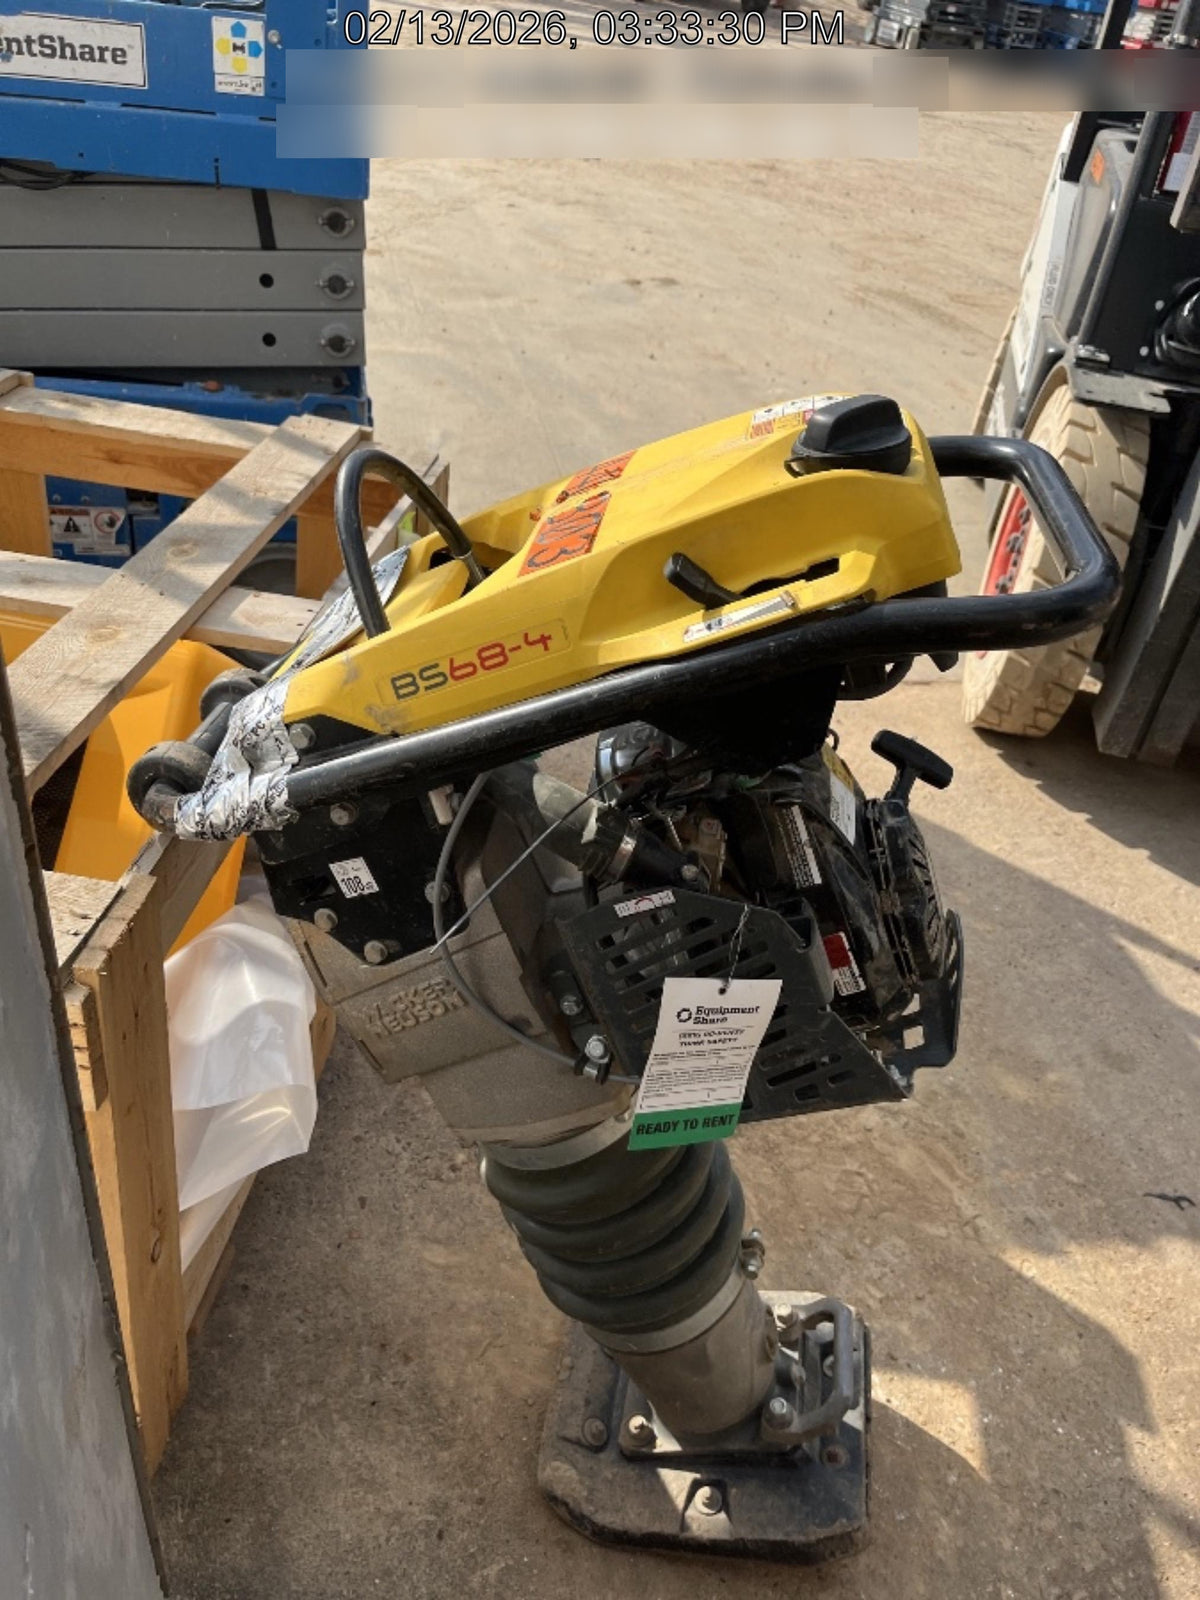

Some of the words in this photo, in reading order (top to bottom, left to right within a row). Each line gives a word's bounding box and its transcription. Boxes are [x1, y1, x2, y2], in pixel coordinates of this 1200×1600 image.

[0, 34, 128, 65] ntShare
[391, 632, 552, 701] BS68-4
[366, 989, 469, 1040] NEUSON
[692, 1016, 728, 1025] Share
[694, 1005, 760, 1017] Equipment
[635, 1119, 682, 1136] READY
[682, 1118, 699, 1129] TO
[702, 1114, 736, 1129] RENT
